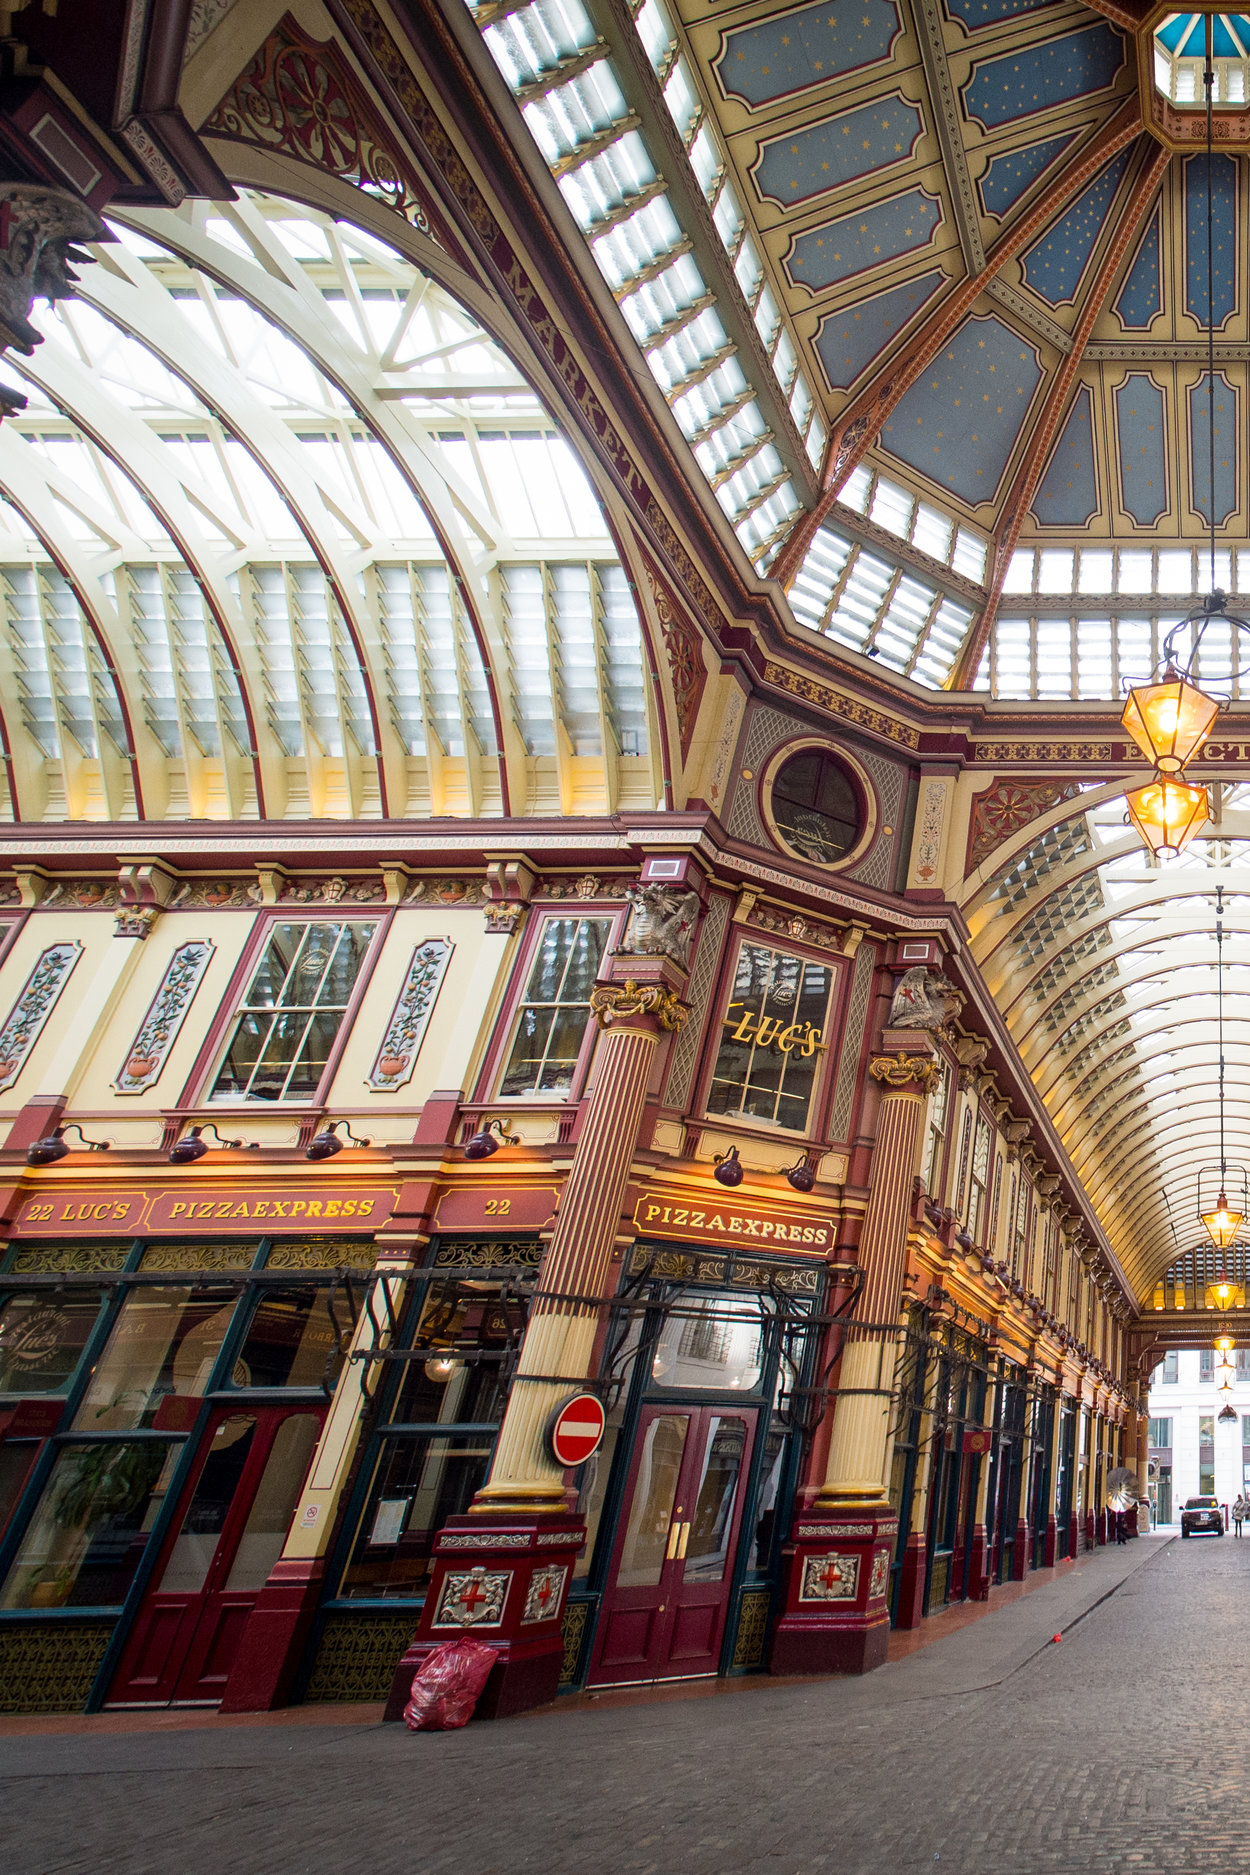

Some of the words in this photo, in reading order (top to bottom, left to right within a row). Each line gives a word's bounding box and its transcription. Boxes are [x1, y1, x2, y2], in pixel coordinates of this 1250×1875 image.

[504, 255, 643, 491] MARKET
[731, 1011, 821, 1057] LUC'S
[25, 1204, 54, 1222] 22
[60, 1200, 131, 1221] LUC'S
[168, 1199, 375, 1219] PIZZAEXPRESS
[484, 1199, 511, 1215] 22
[645, 1205, 828, 1245] PIZZAEXPRESS
